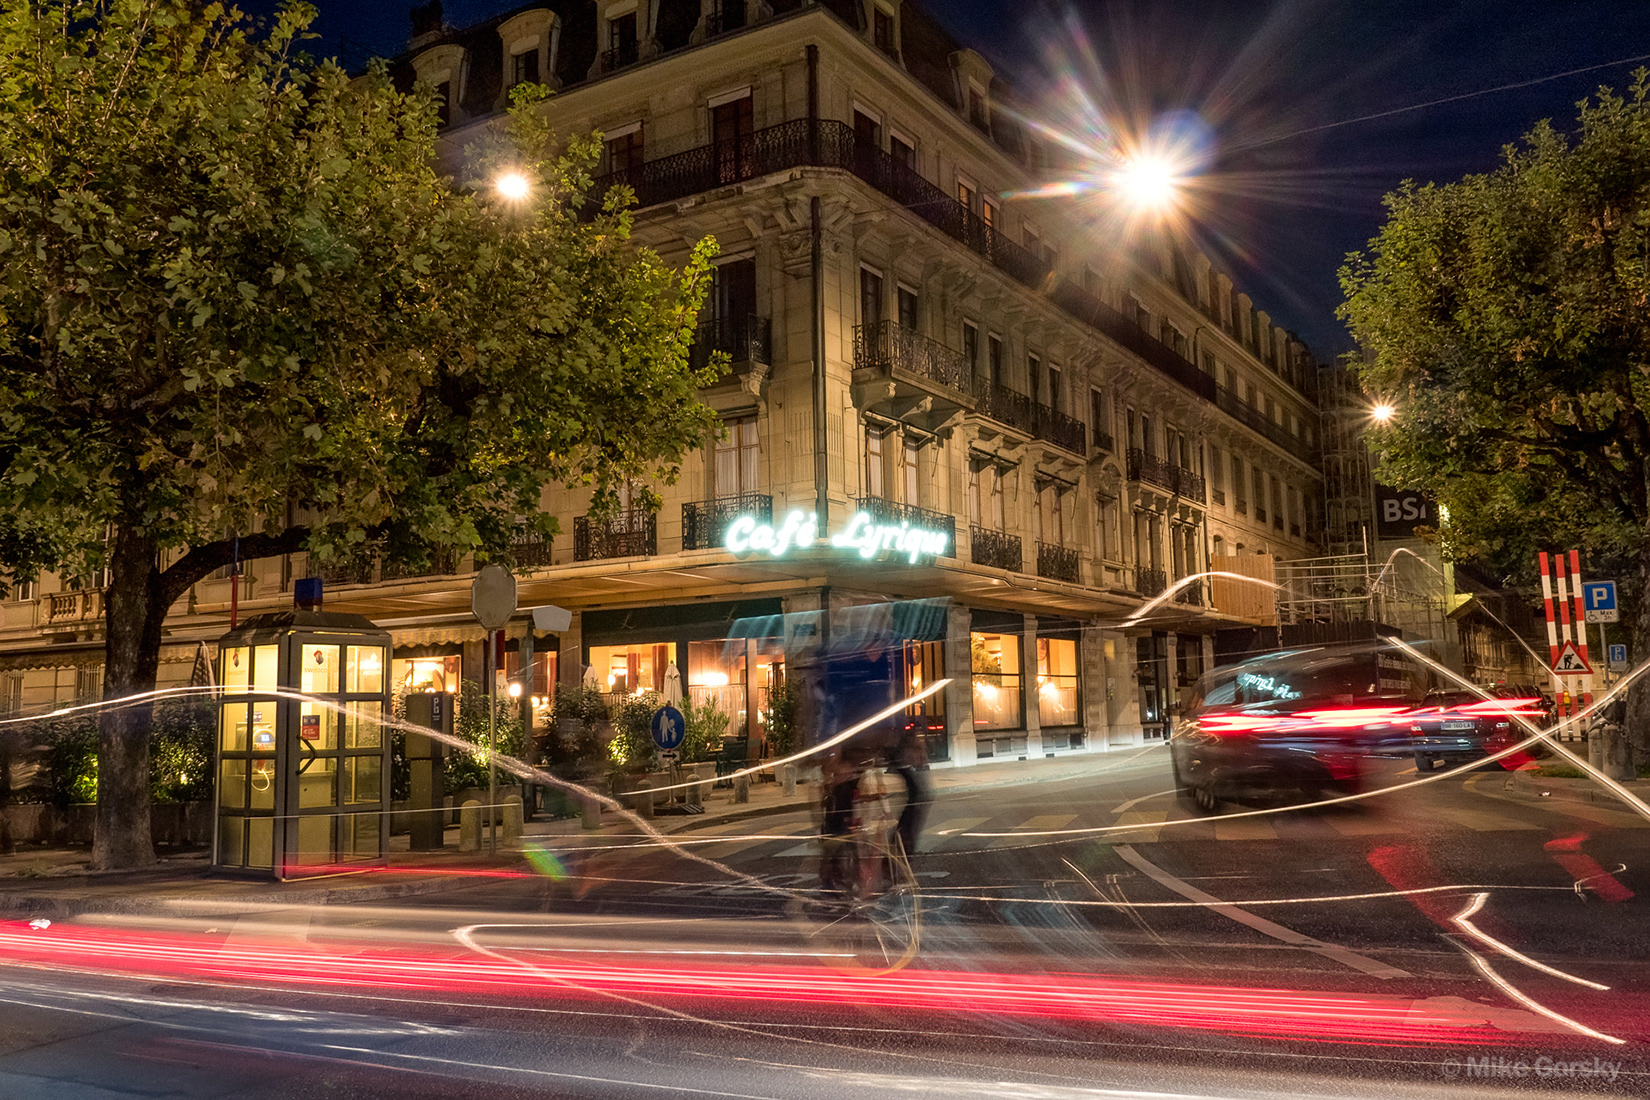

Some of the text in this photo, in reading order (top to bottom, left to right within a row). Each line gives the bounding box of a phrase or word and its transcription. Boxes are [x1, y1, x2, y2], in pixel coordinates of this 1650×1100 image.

[726, 509, 949, 564] Café Lyrique
[1592, 587, 1608, 608] P
